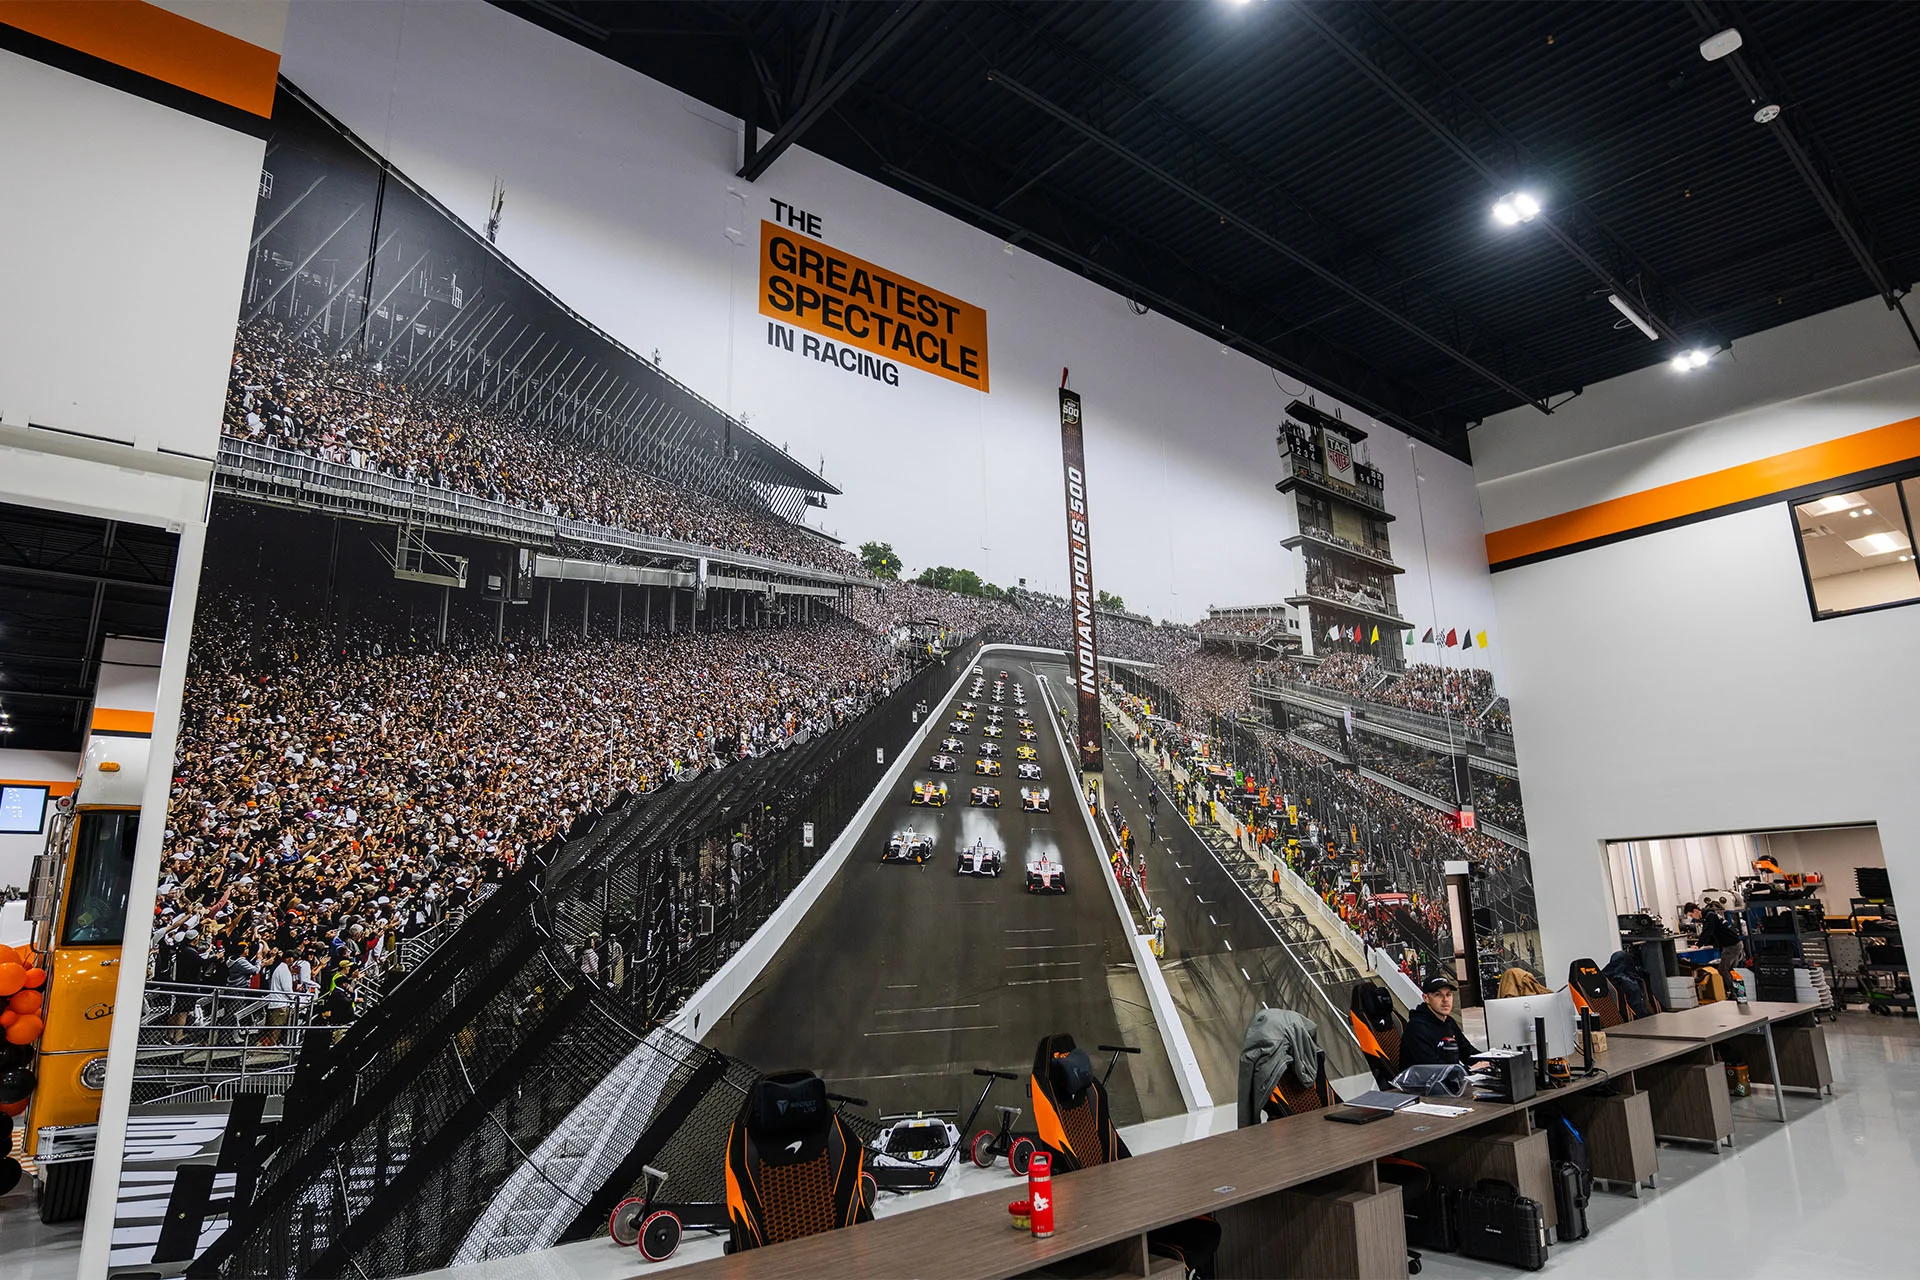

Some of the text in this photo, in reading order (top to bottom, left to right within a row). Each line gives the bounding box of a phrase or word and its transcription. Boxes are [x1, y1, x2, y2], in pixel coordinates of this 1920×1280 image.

[770, 197, 822, 238] THE
[769, 236, 960, 334] GREATEST
[768, 275, 979, 380] SPECTACLE
[767, 322, 899, 387] IN RACING
[1063, 404, 1079, 418] 500
[1328, 438, 1348, 455] TAG
[1328, 450, 1350, 470] HEUER
[1068, 466, 1096, 695] INDIANAPOLIS 500
[929, 1171, 935, 1182] 7
